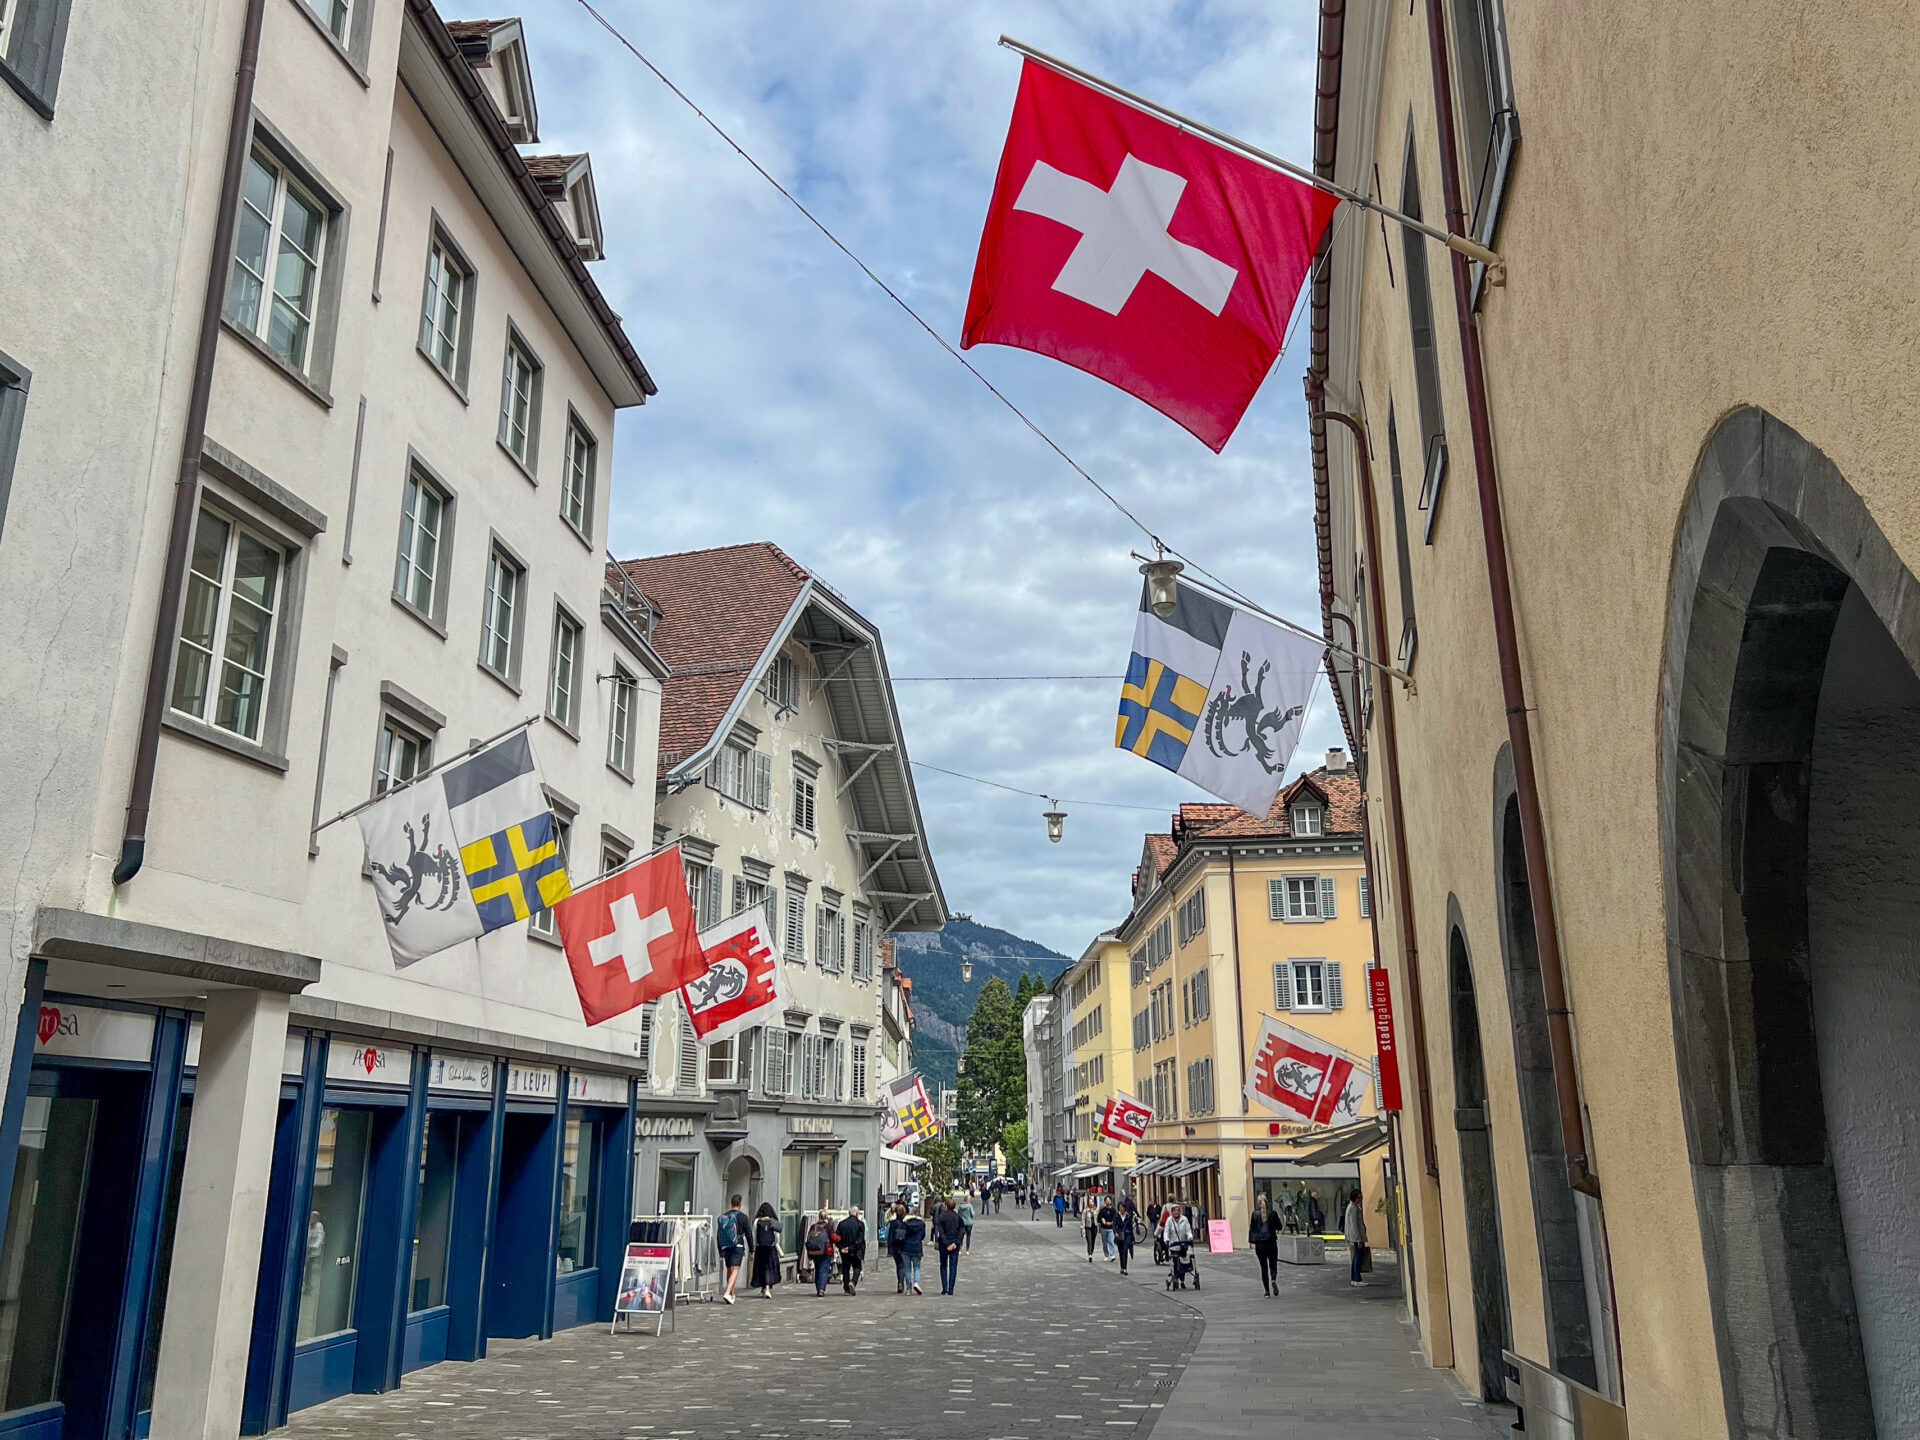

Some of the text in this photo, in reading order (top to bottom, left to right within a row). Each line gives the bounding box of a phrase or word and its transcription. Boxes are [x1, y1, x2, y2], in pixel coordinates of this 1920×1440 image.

[1375, 981, 1392, 1051] stadtgalerie
[523, 1071, 551, 1093] LEUPI
[651, 1117, 694, 1136] MODA
